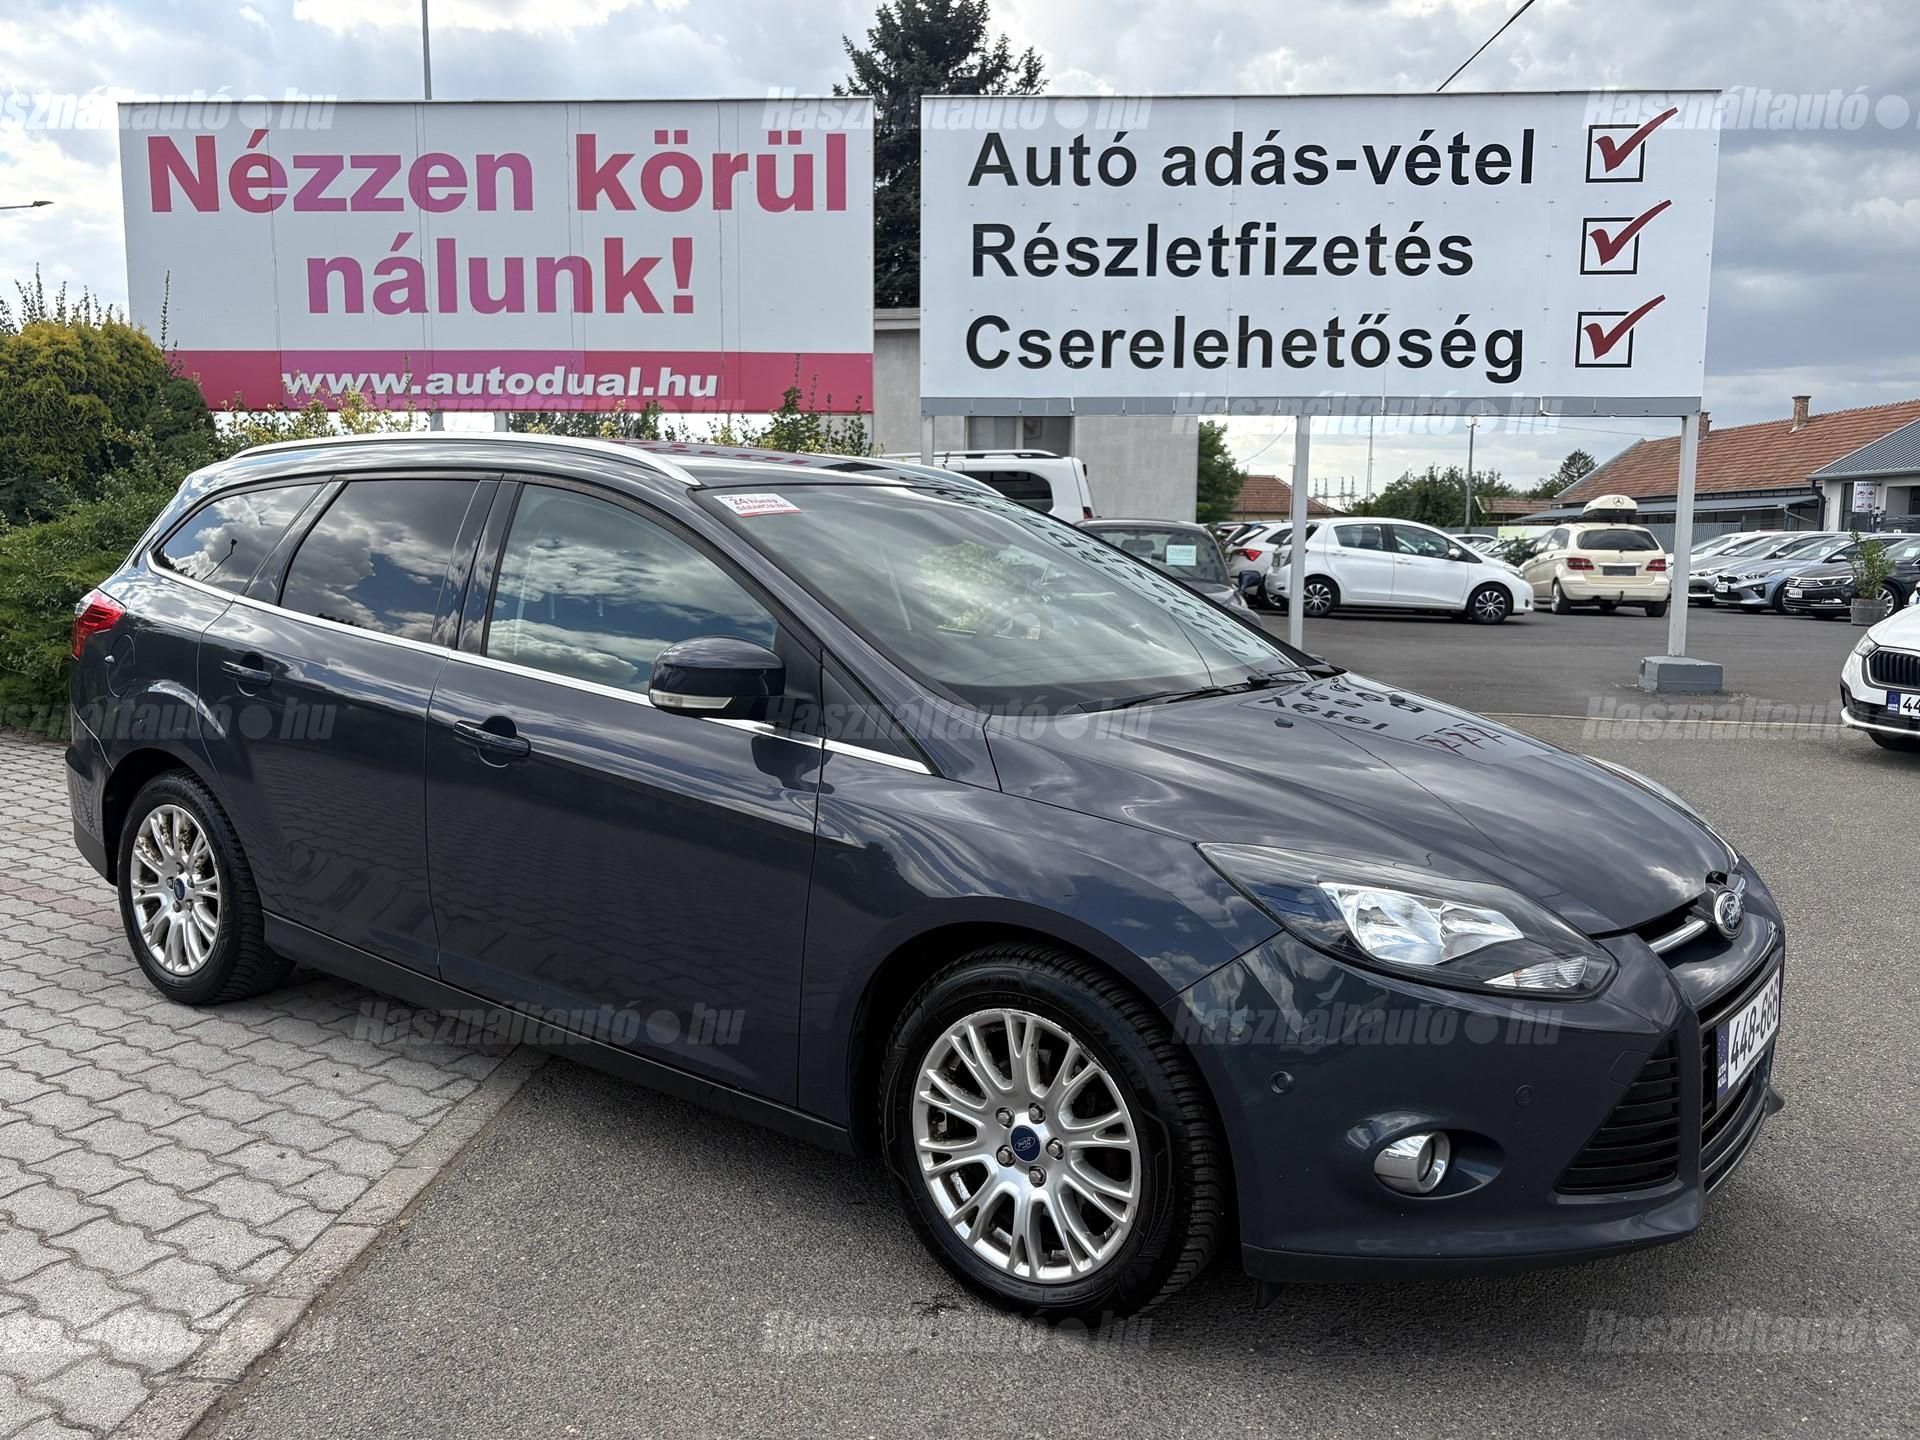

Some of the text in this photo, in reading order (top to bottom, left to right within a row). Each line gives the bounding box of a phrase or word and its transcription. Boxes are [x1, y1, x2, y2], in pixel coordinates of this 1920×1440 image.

[147, 129, 847, 213] Nézzen körül
[967, 127, 1535, 188] Autó adás-vétel
[307, 233, 694, 315] nálunk!
[971, 219, 1474, 278] Részletfizetés
[965, 310, 1524, 384] Cserelehetőség
[282, 366, 718, 399] www.autodual.hu
